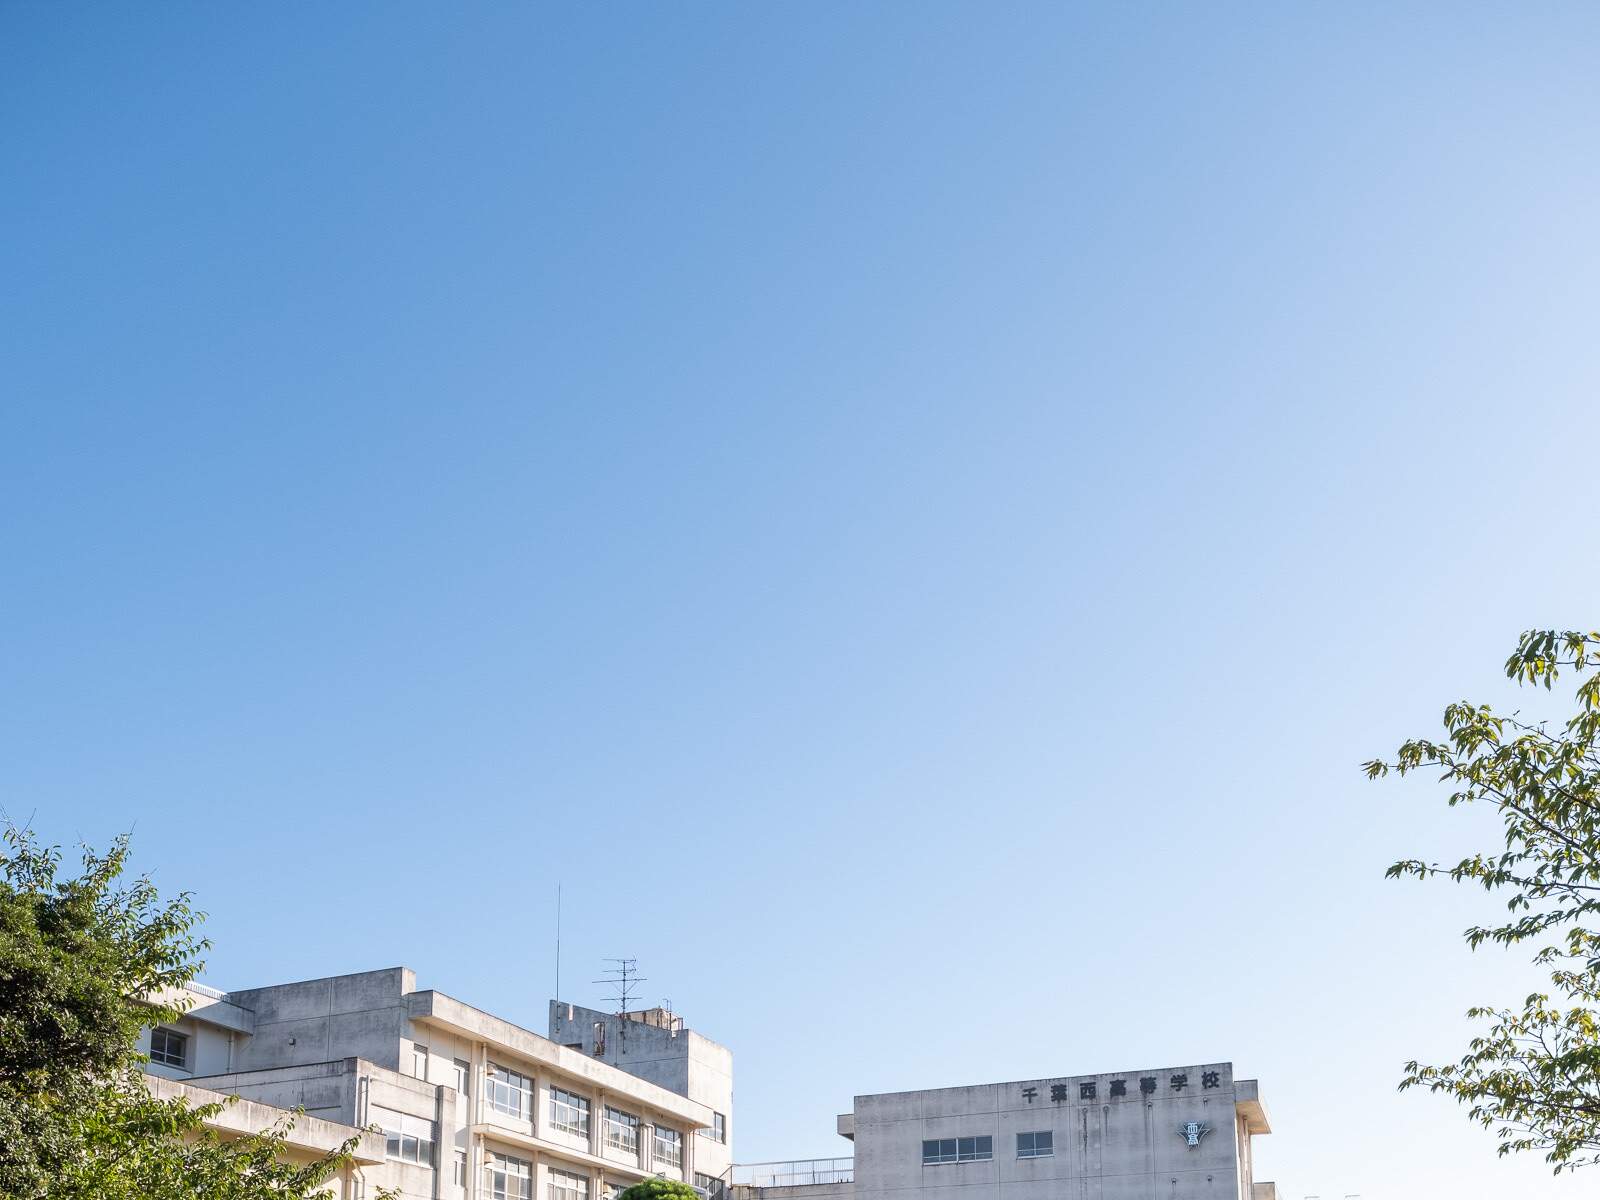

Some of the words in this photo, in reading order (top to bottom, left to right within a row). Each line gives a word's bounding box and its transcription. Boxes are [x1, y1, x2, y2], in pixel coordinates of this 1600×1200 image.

[1022, 1071, 1220, 1104] 千葉西高等学校
